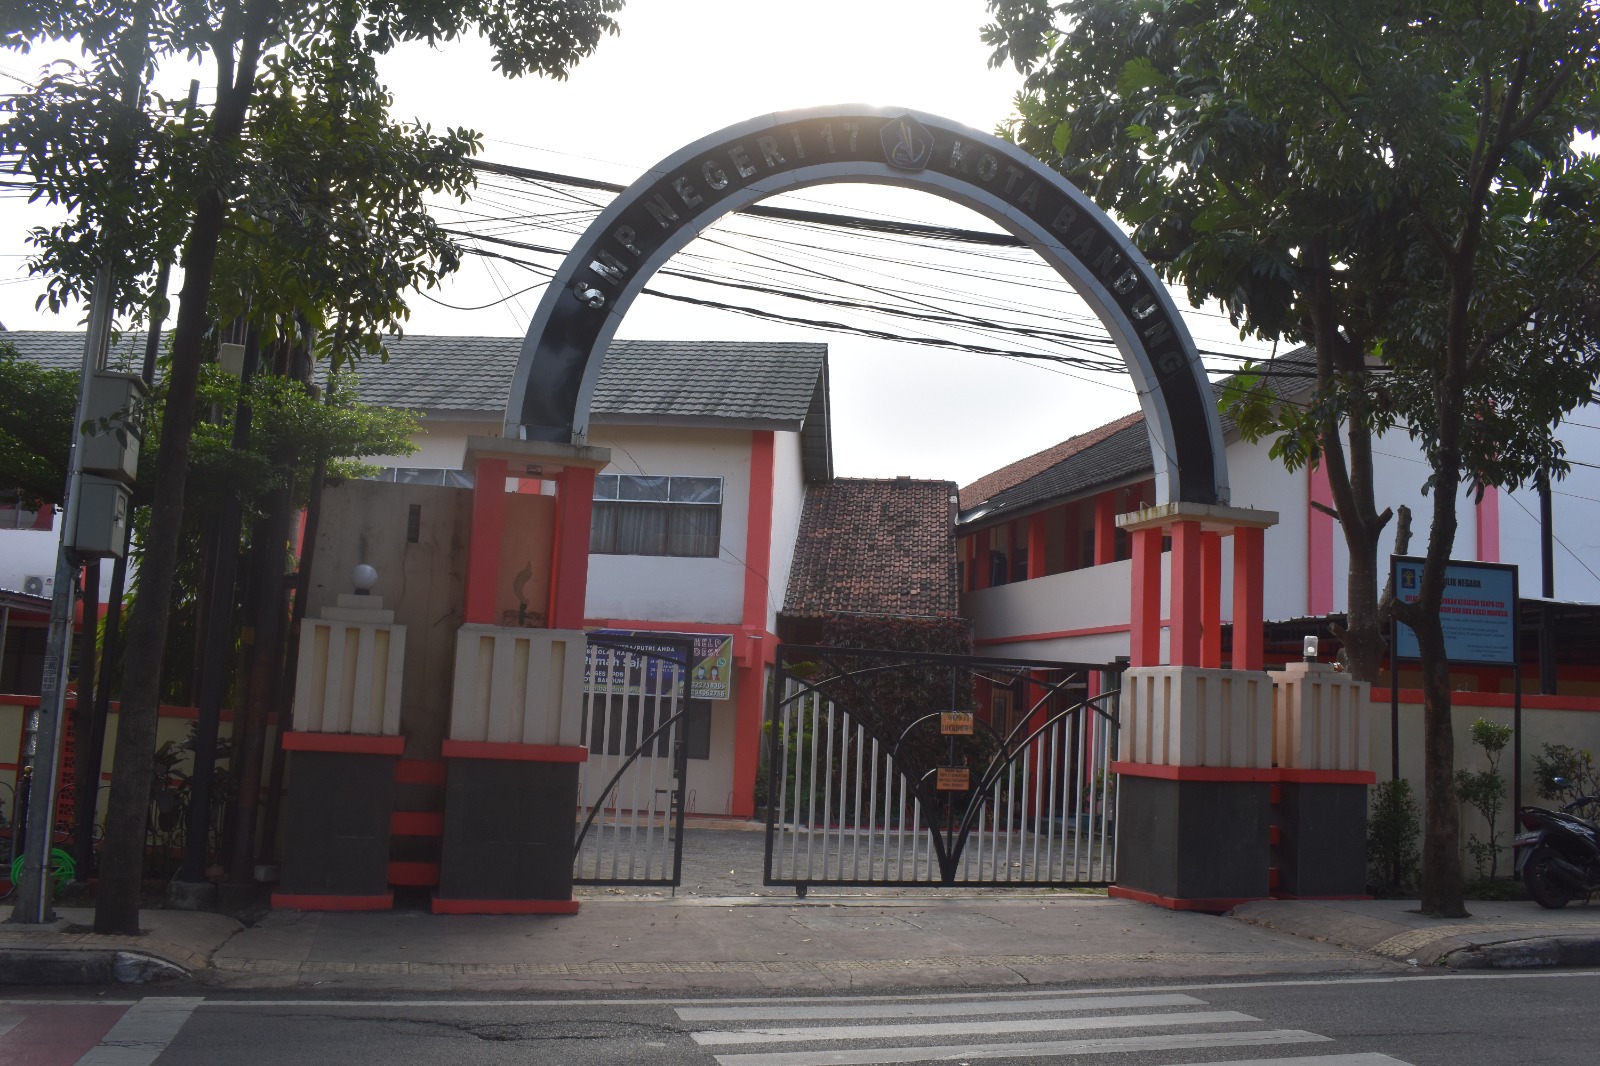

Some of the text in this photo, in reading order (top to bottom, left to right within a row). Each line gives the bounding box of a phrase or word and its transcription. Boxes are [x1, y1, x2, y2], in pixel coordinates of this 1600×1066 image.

[572, 122, 1184, 376] SMP NEGERI 17 KOTA BANDUNG
[693, 638, 722, 648] HELP
[693, 647, 721, 657] DESK
